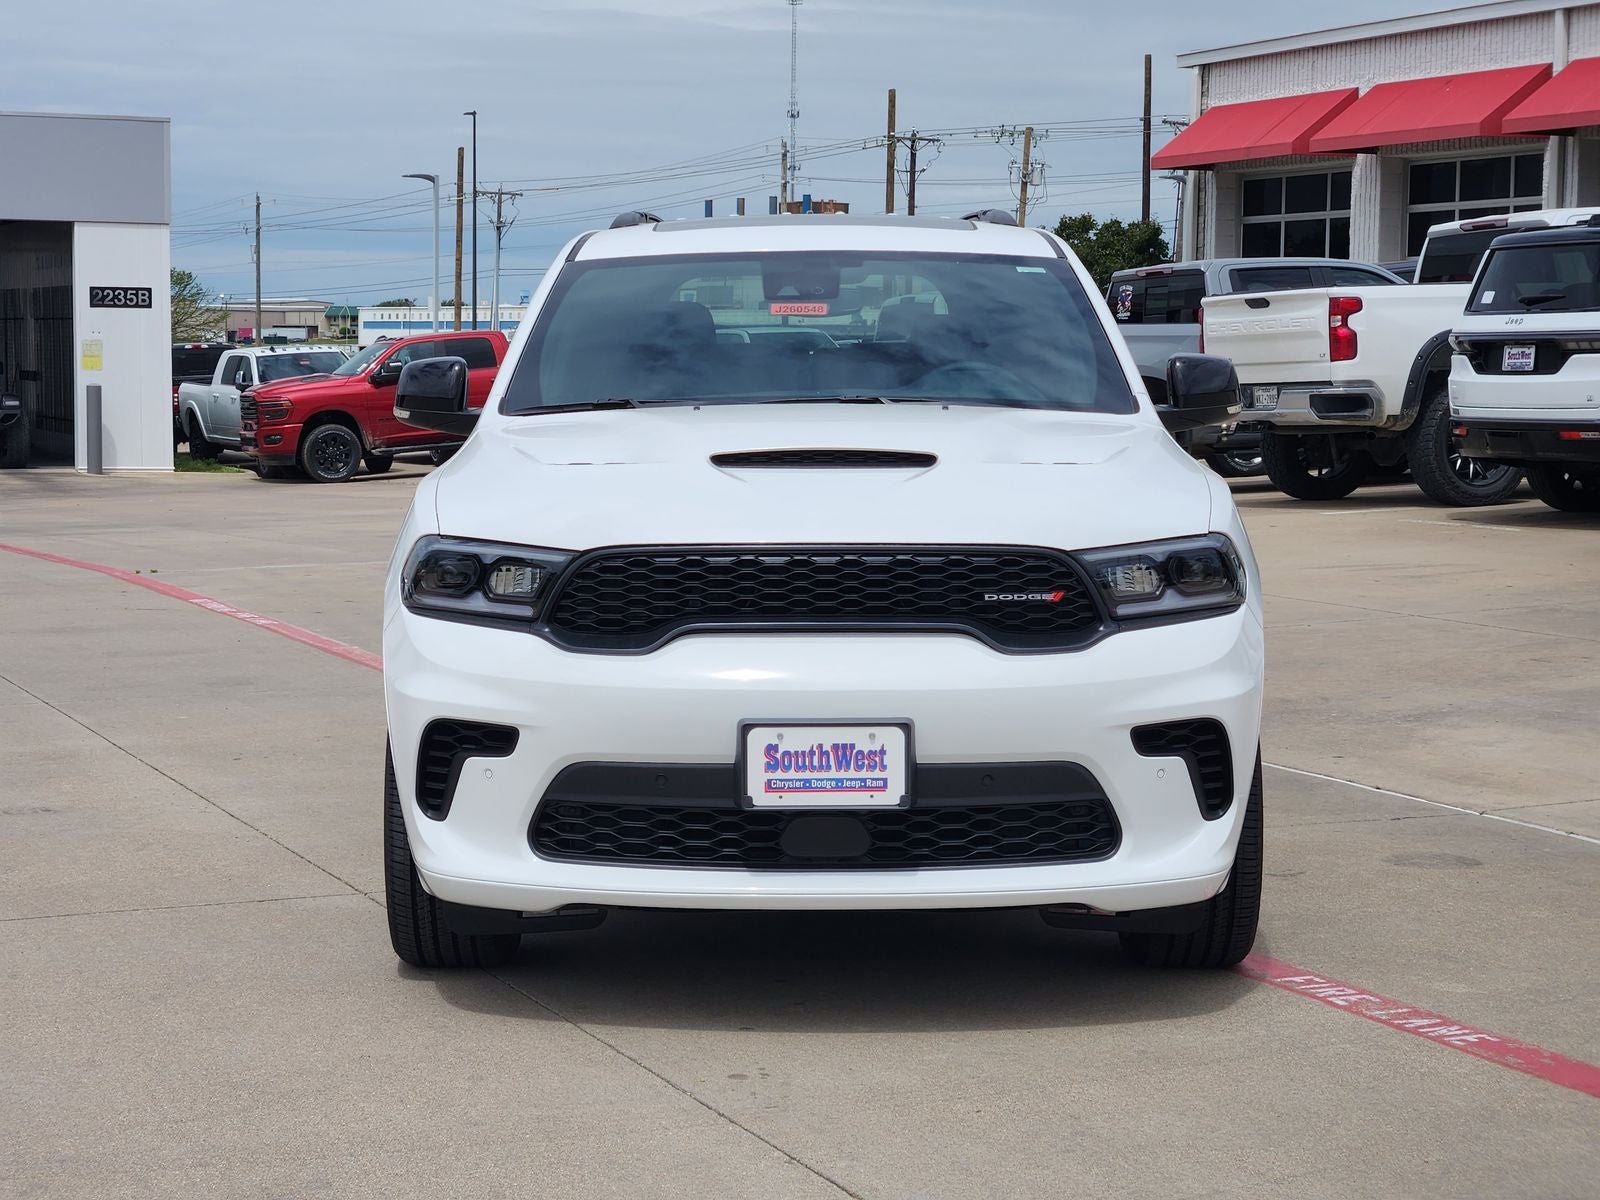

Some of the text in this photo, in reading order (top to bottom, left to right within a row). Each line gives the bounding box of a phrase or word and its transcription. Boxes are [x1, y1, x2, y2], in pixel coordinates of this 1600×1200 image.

[92, 289, 150, 305] 2235B
[775, 305, 824, 313] J260548
[1208, 317, 1316, 335] CHEVROLET
[1505, 316, 1523, 325] Jeep
[984, 593, 1054, 601] DODGE
[764, 743, 888, 774] SouthWest
[771, 779, 884, 790] Chrysler Dodge Jeep Ram
